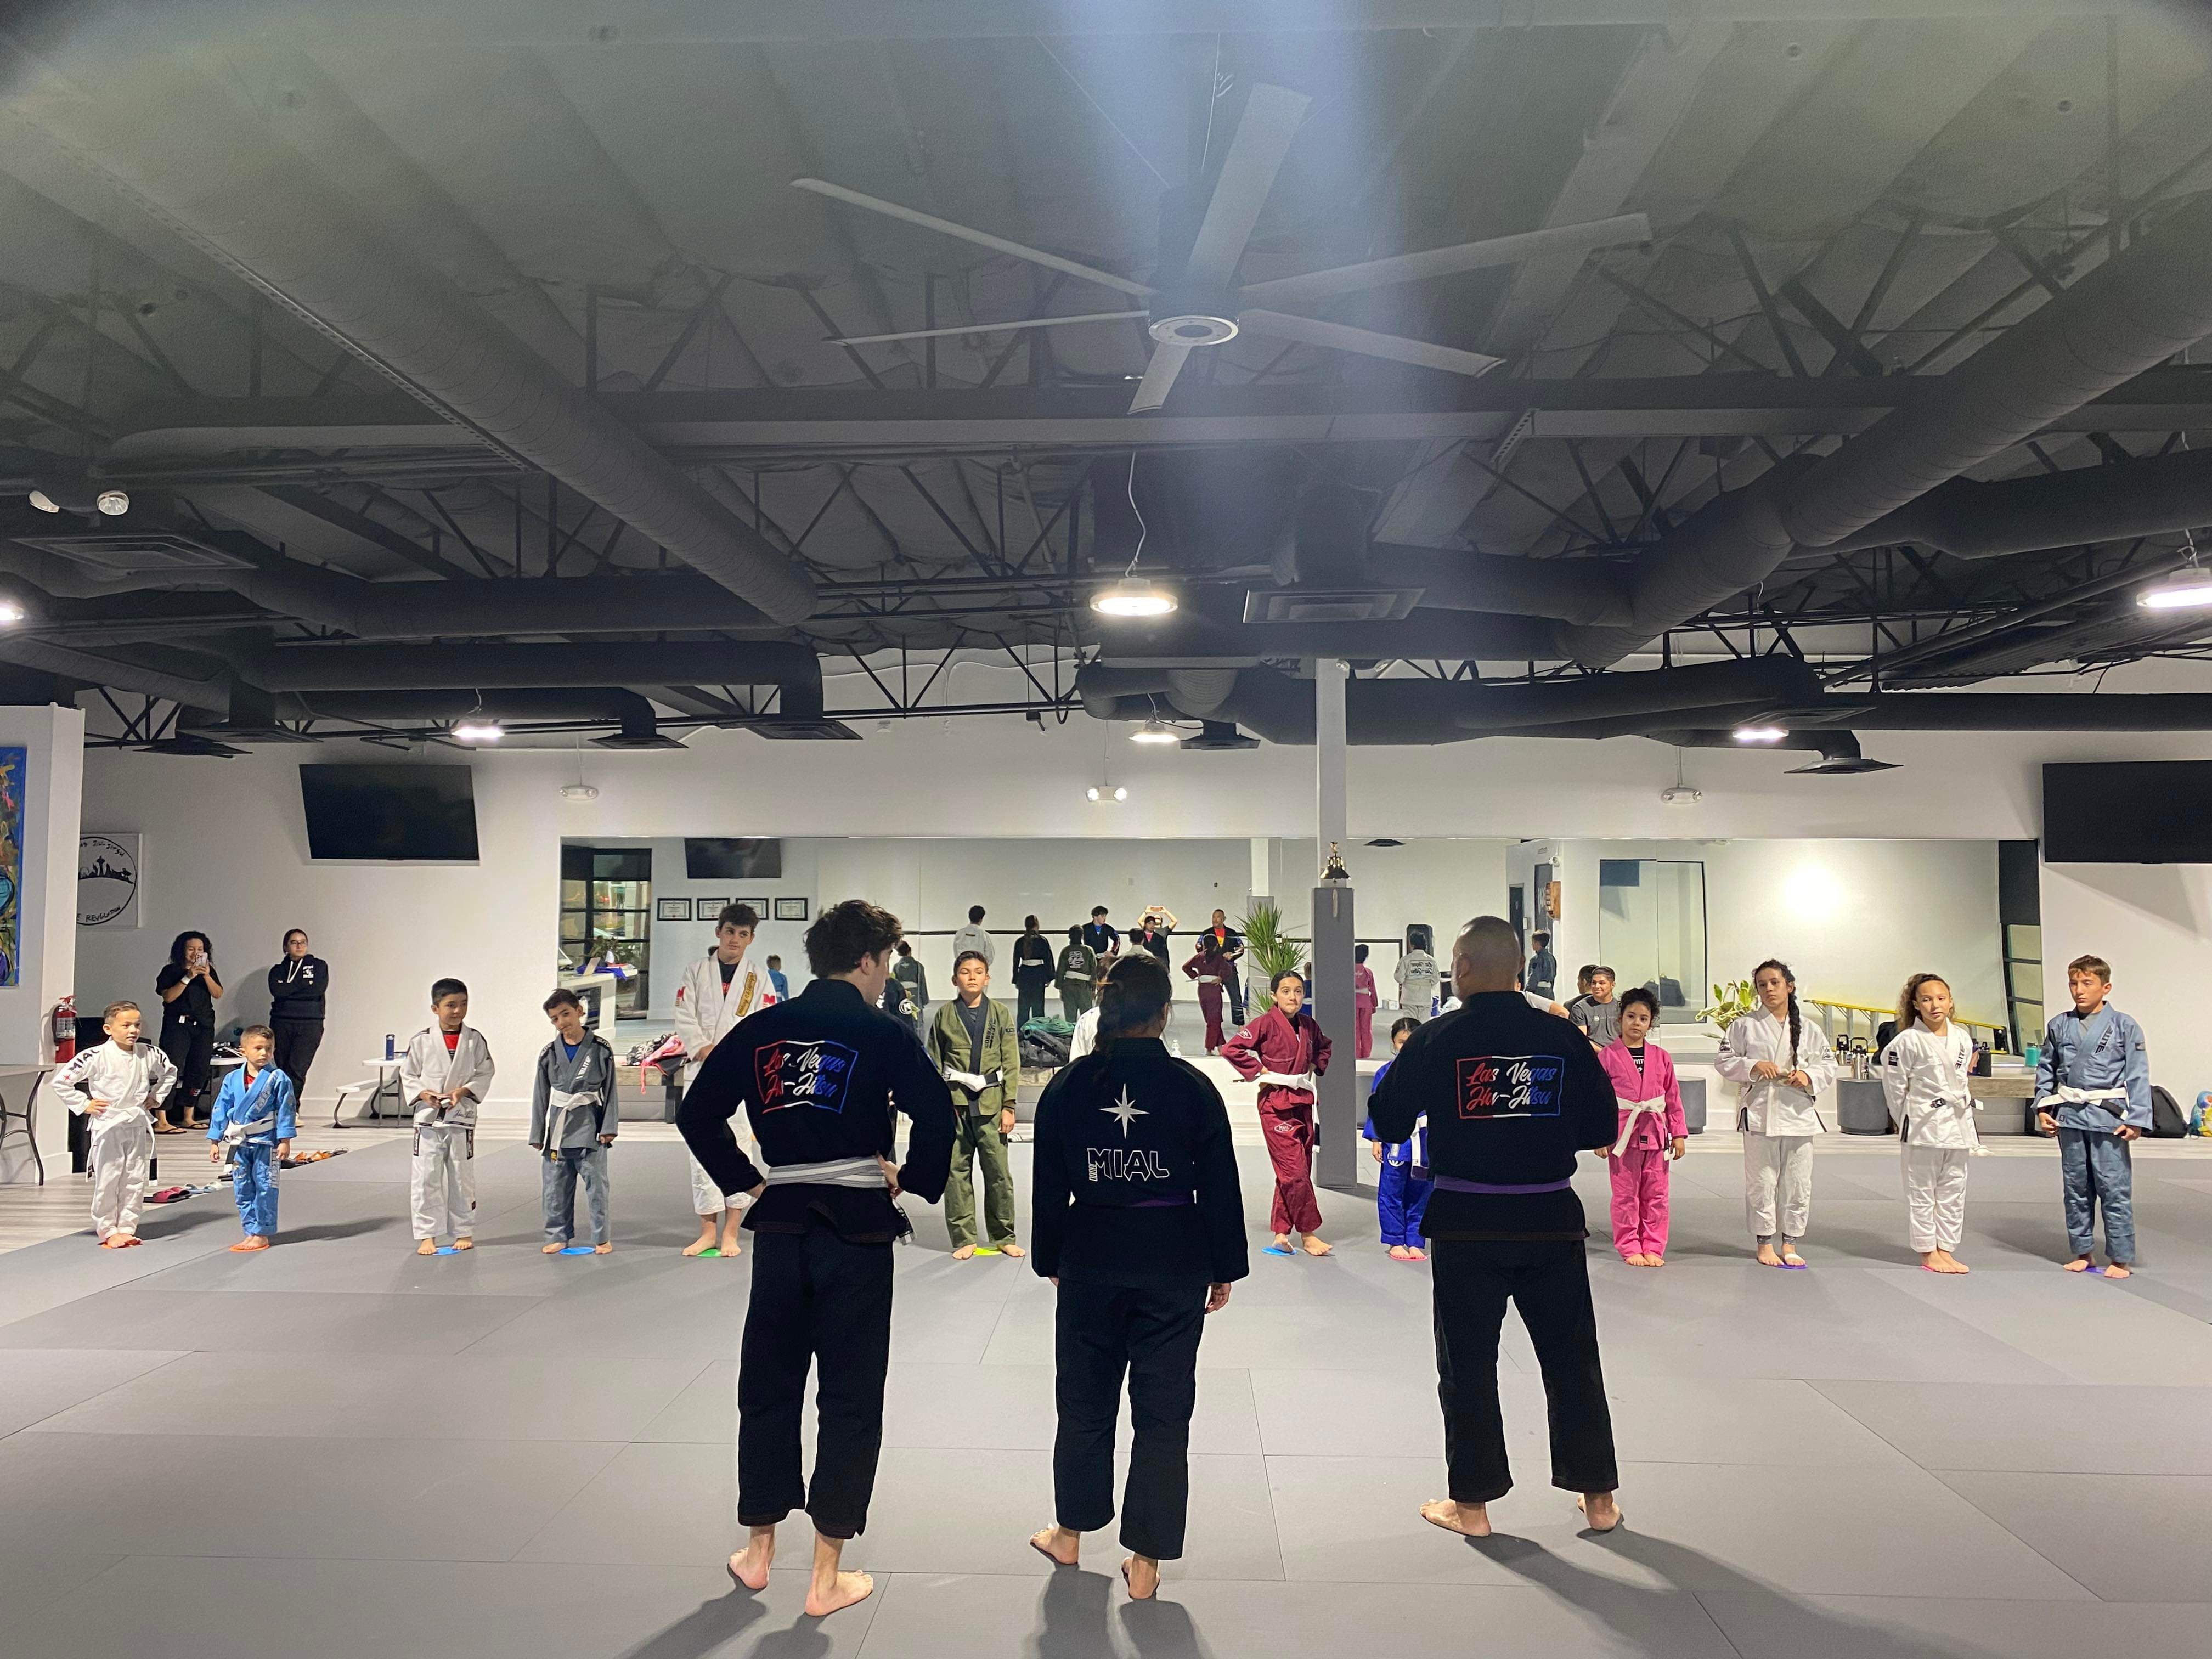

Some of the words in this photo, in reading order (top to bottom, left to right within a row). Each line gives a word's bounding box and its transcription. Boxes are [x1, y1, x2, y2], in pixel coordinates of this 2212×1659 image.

[2095, 1025, 2113, 1054] ELITE
[67, 1049, 100, 1071] MIAL
[1955, 1042, 1965, 1070] ELITE
[1466, 1062, 1499, 1087] Las
[1506, 1062, 1557, 1085] Vegas
[1466, 1085, 1552, 1111] Jiu-Jitsu
[1087, 1148, 1170, 1182] MIAL
